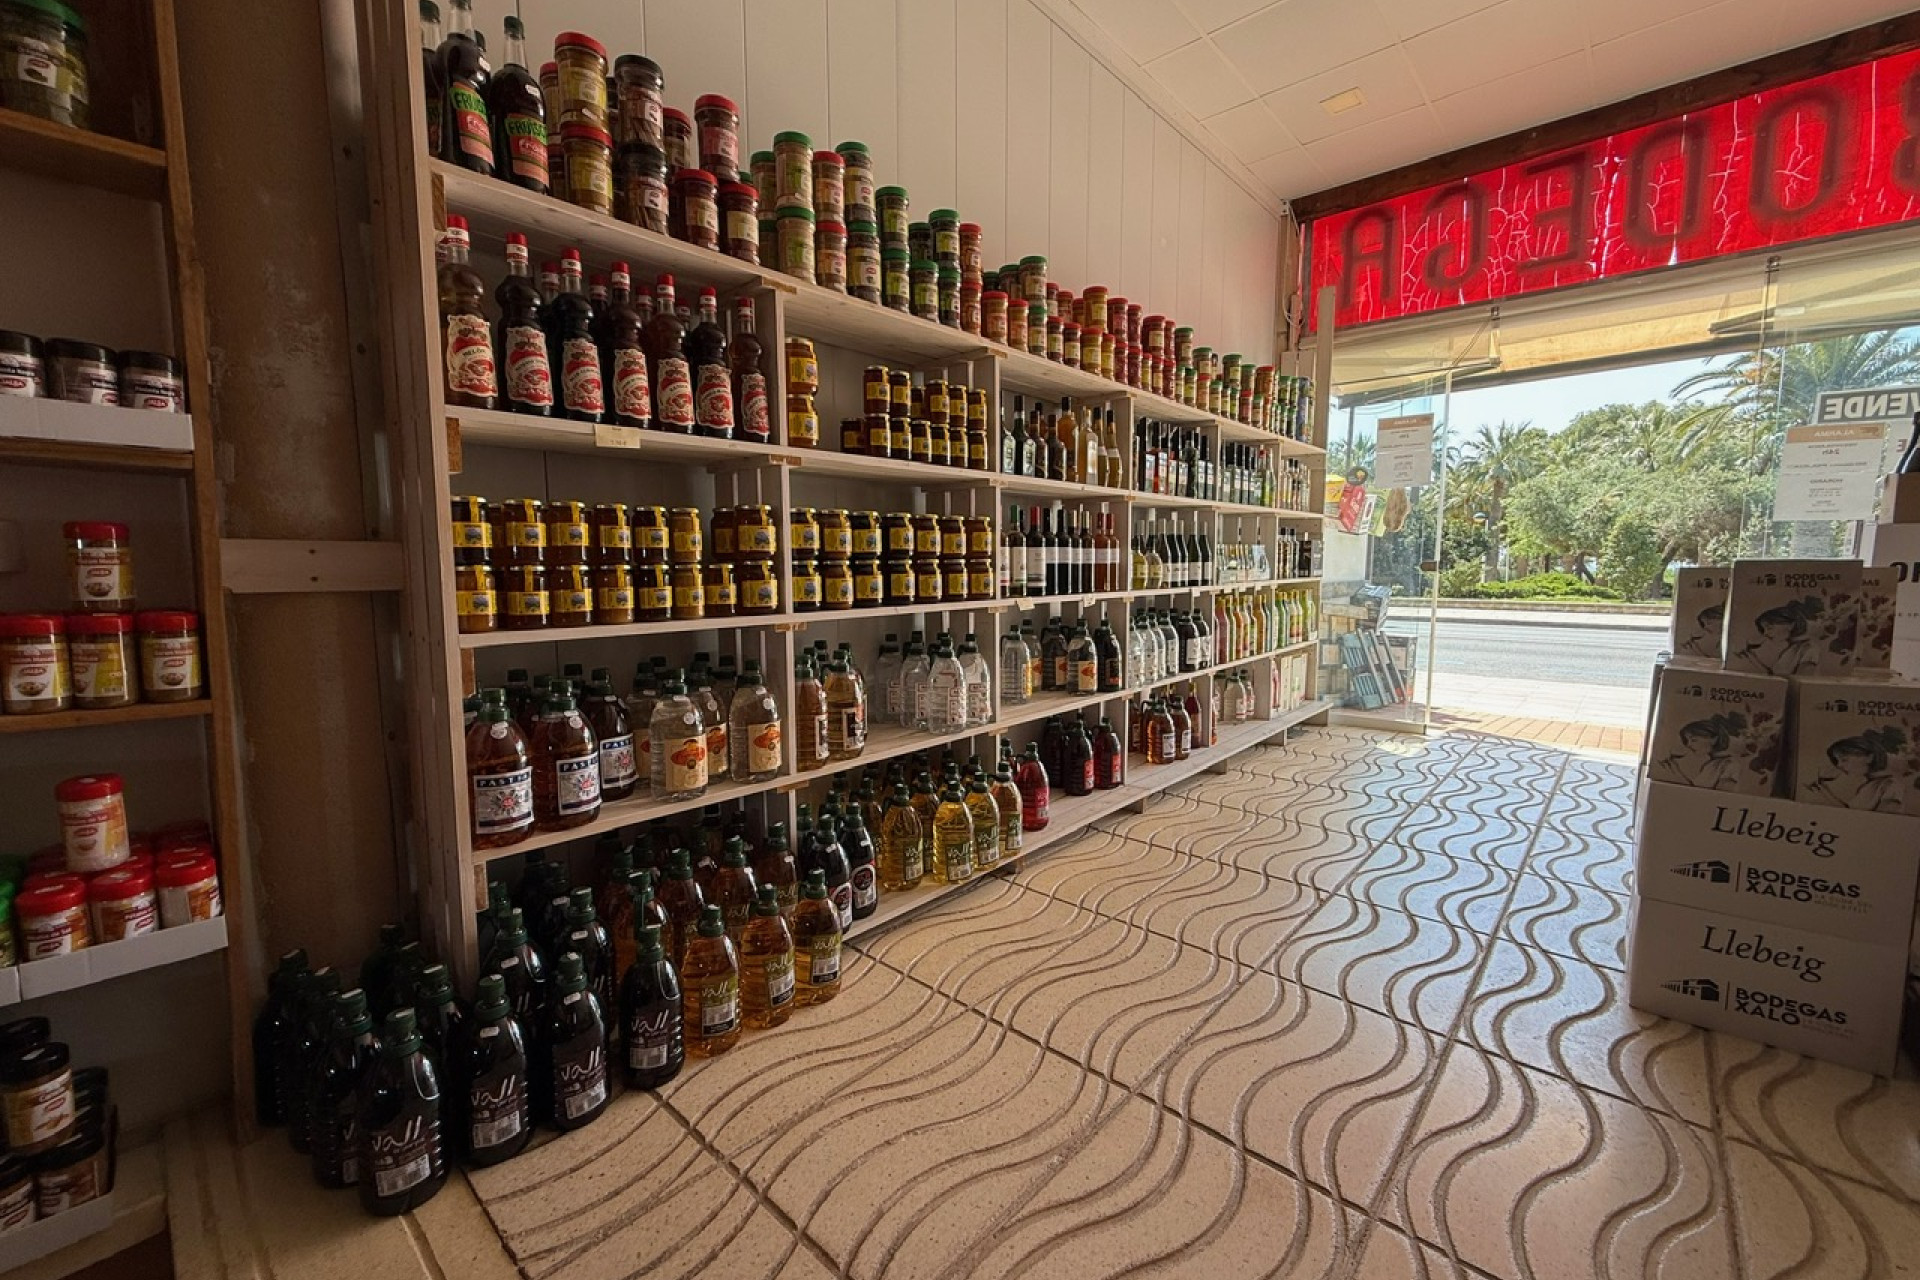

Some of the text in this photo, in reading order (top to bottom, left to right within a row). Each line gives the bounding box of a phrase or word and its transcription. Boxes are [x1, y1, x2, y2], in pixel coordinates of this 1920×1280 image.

[1784, 573, 1841, 581] BODEGAS
[1784, 580, 1818, 588] XALO
[1709, 687, 1765, 700] BODEGAS
[1857, 708, 1896, 717] XALO
[1711, 806, 1839, 858] Llebeig
[1745, 879, 1813, 902] XALO
[1746, 867, 1861, 898] BODEGAS
[1700, 925, 1826, 983] Llebeig
[1734, 1001, 1801, 1026] XALO
[1735, 987, 1848, 1025] BODEGAS
